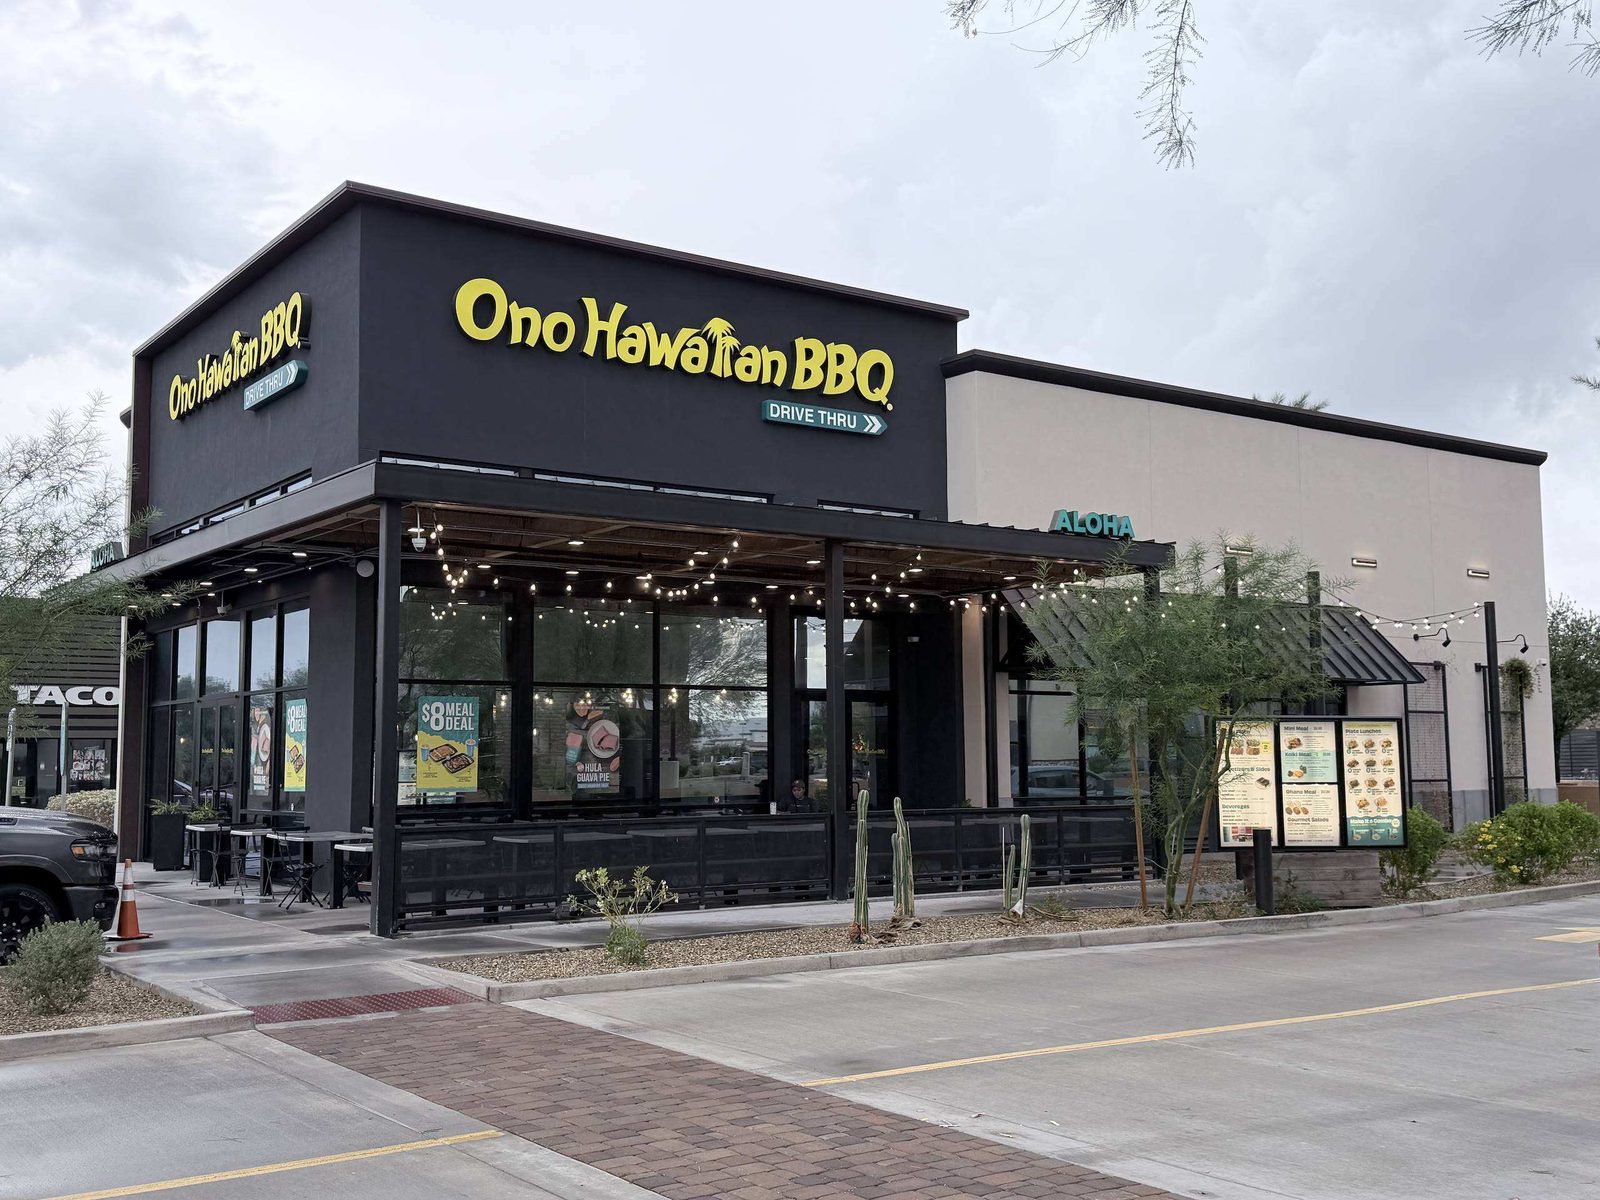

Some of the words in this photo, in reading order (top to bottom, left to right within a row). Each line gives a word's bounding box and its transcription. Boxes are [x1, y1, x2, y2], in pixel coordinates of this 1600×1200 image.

[169, 374, 197, 421] Ono
[197, 330, 259, 403] Hawaiian
[260, 291, 302, 366] BBQ
[455, 278, 576, 353] Ono
[581, 297, 788, 387] Hawaiian
[791, 336, 895, 407] BBQ
[245, 383, 264, 406] DRIVE
[265, 372, 283, 394] THRU
[769, 403, 815, 423] DRIVE
[817, 409, 857, 429] THRU
[1053, 508, 1136, 538] ALOHA
[9, 684, 121, 706] TACO
[422, 701, 445, 732] $8
[445, 702, 475, 717] MEAL
[445, 716, 475, 731] DEAL
[576, 772, 598, 783] GUAVA
[599, 772, 610, 782] PIE
[584, 762, 602, 773] HULA
